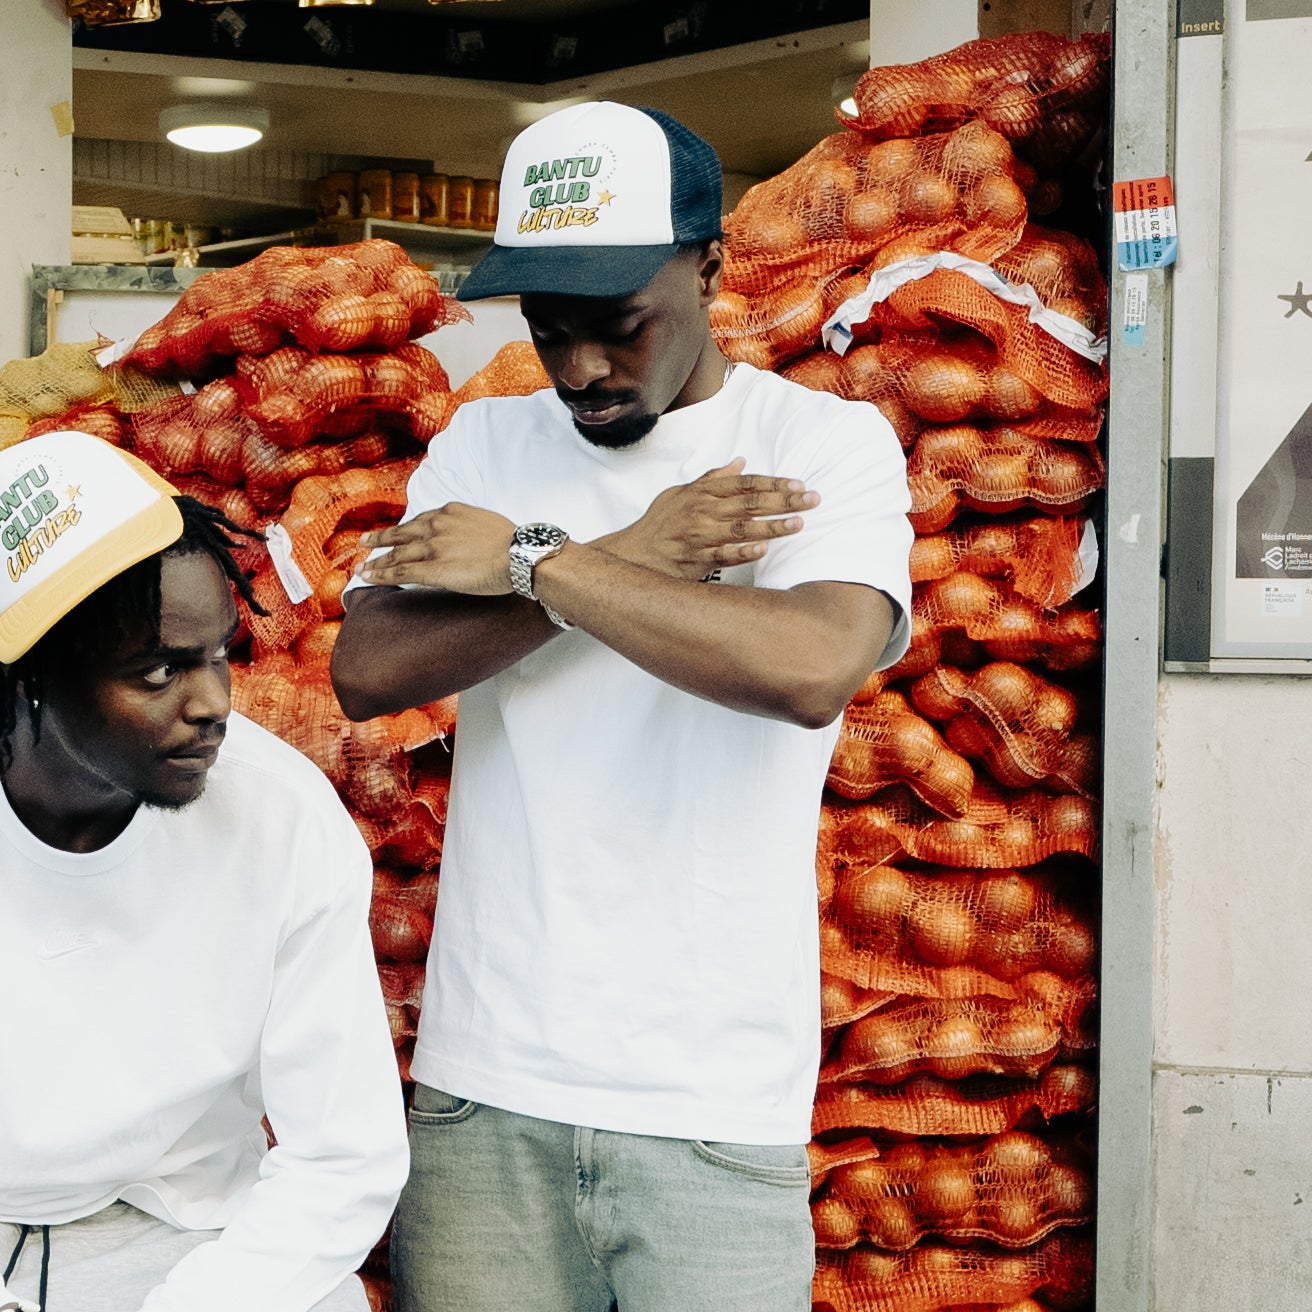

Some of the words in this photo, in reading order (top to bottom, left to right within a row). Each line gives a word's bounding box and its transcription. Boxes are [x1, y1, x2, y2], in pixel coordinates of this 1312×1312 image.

[523, 156, 602, 187] BANTU
[529, 182, 590, 208] CLUB
[1147, 182, 1156, 192] 15
[1148, 194, 1158, 206] 28
[517, 205, 599, 235] CULTURE
[1150, 207, 1158, 218] 15
[1151, 220, 1159, 231] 20
[1152, 233, 1161, 244] 06
[1, 489, 59, 551] CLUB
[7, 503, 82, 582] CULTURE
